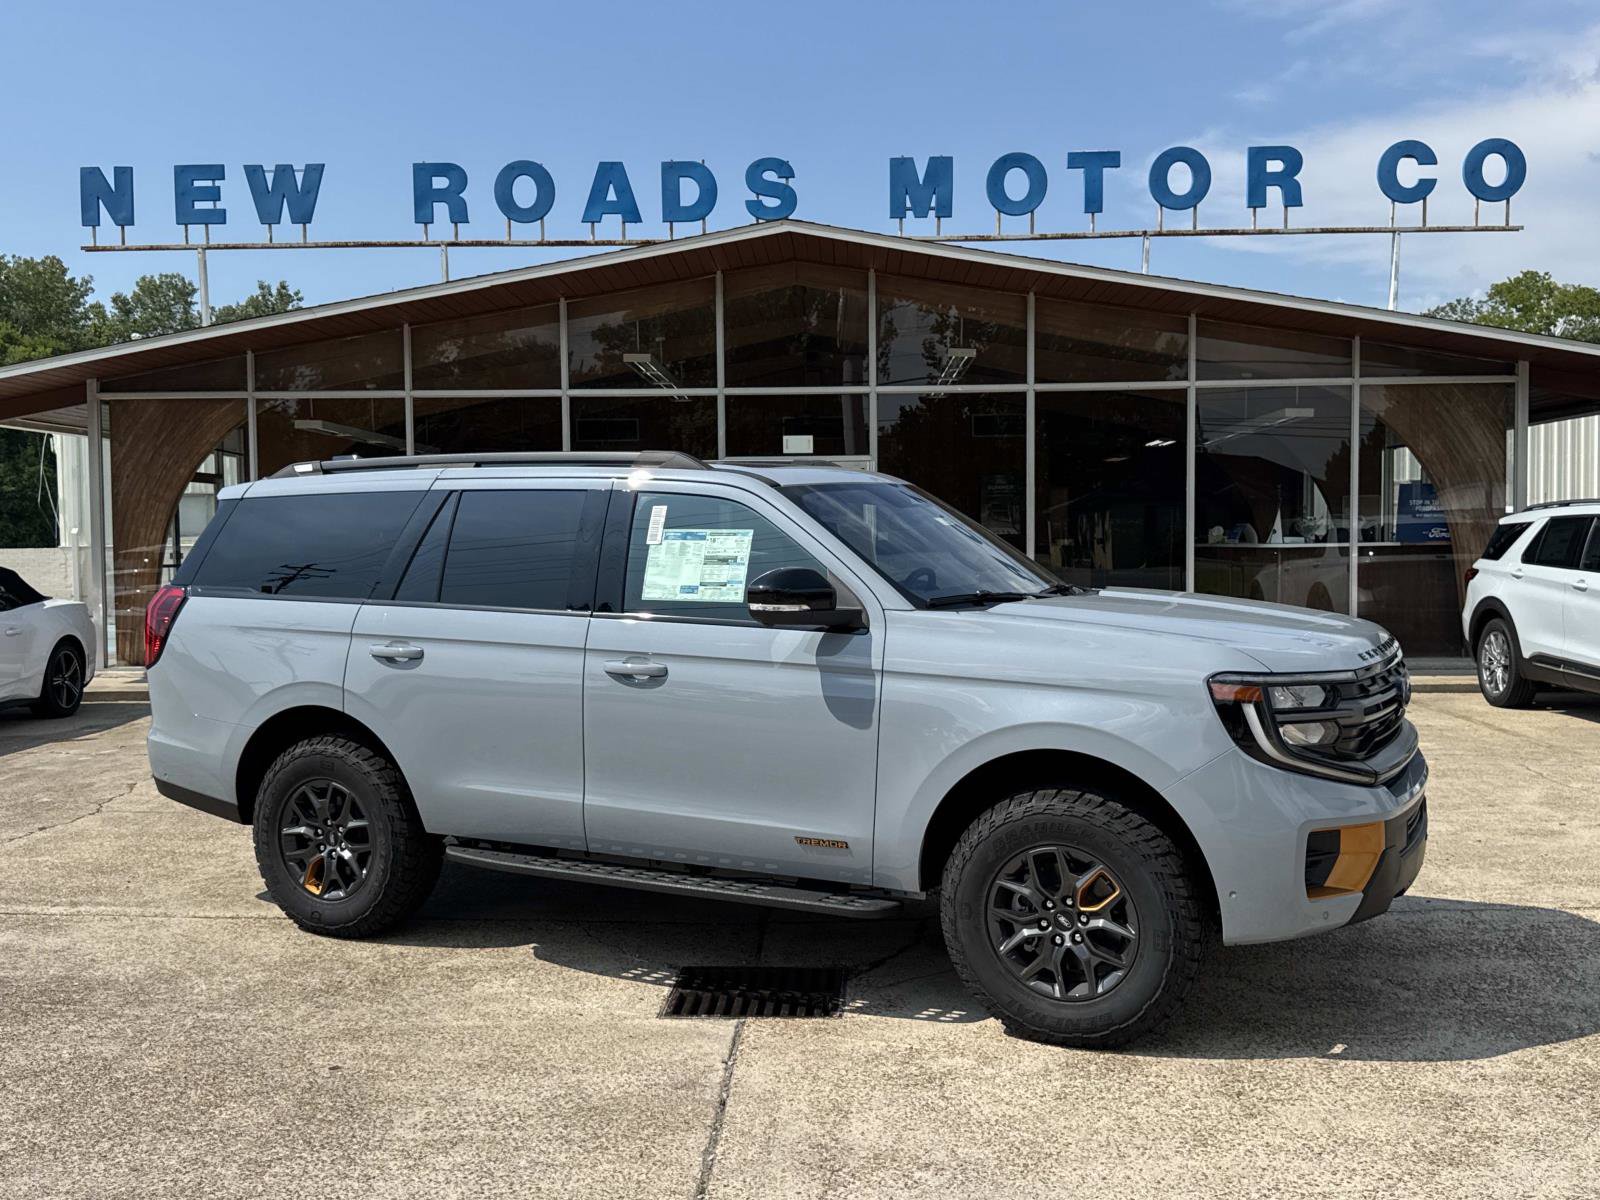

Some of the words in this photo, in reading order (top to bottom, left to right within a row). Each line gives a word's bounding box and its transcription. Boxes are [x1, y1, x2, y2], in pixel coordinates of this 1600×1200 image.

[80, 162, 325, 227] NEW
[413, 157, 798, 226] ROADS
[889, 145, 1304, 220] MOTOR
[1377, 138, 1527, 204] CO
[794, 837, 849, 849] TREMOR
